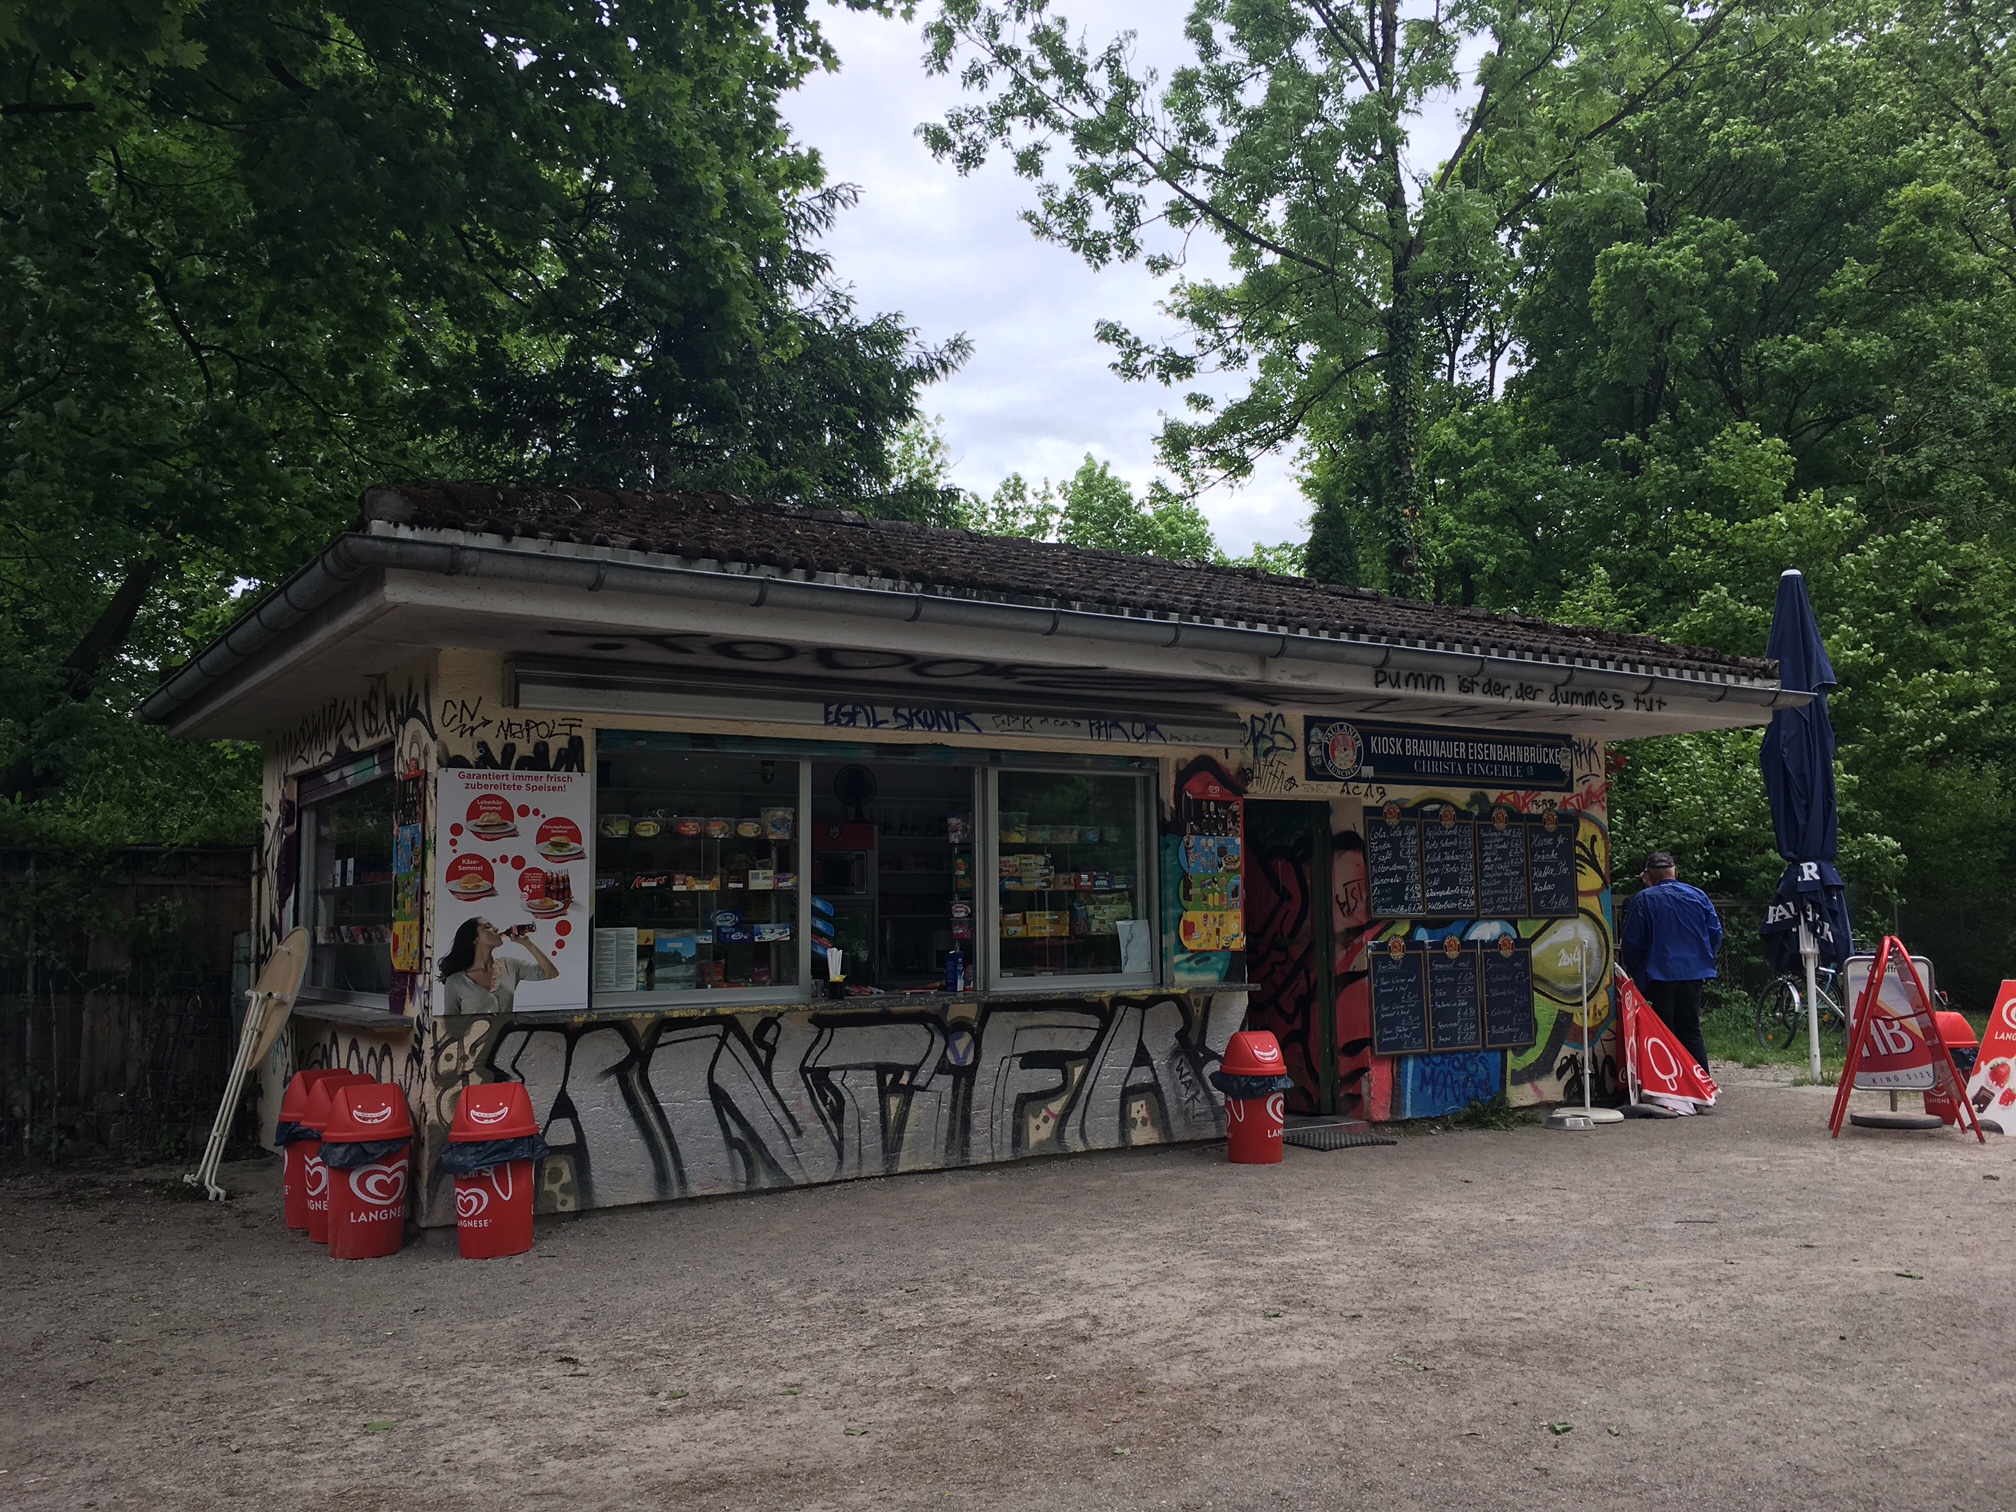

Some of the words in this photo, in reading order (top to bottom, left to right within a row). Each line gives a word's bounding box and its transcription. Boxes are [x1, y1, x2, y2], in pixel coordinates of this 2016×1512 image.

[1457, 674, 1478, 694] ist
[1515, 682, 1543, 701] der
[1550, 685, 1625, 711] dummes
[1633, 691, 1667, 712] tut
[824, 702, 889, 729] EGAL
[892, 706, 983, 733] SKUNK
[1325, 724, 1361, 747] PAULANER
[1370, 735, 1402, 755] KIOSK
[1405, 738, 1466, 760] BRAUNAUER
[1468, 742, 1561, 765] EISENBAHNBRÜCKE
[458, 771, 509, 781] Garantiert
[512, 773, 544, 782] immer
[546, 773, 573, 783] frisch
[1413, 759, 1463, 775] CHRISTA
[1466, 762, 1523, 778] FINGERLE
[464, 782, 522, 791] zubereitete
[525, 783, 567, 793] Speisen!
[1871, 1075, 1900, 1085] KING
[1906, 1071, 1932, 1081] SIZE
